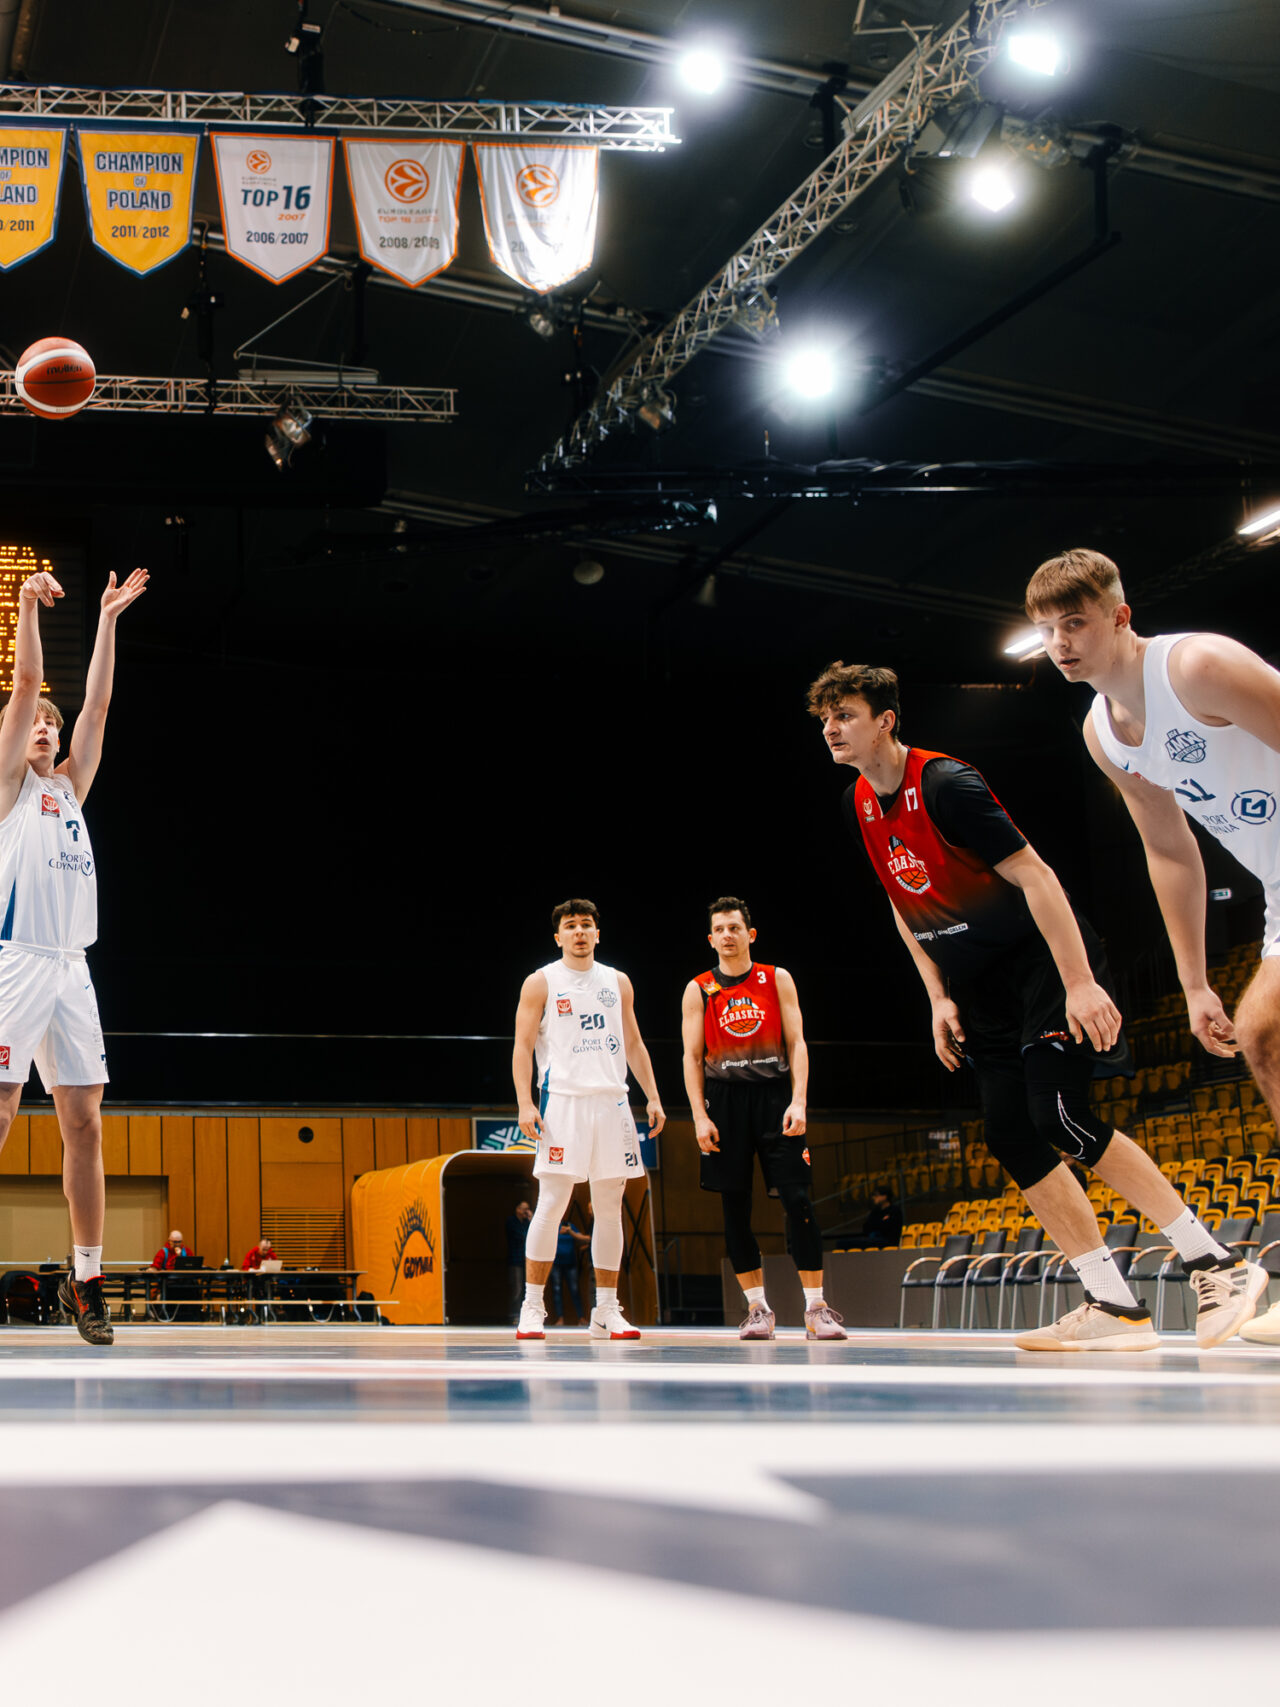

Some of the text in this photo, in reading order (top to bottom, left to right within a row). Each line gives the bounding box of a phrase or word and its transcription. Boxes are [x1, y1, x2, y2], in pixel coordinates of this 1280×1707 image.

[94, 152, 183, 174] CHAMPION
[0, 170, 11, 181] OF
[134, 176, 146, 187] OF
[106, 189, 173, 211] POLAND
[242, 185, 311, 210] TOP 16
[278, 213, 306, 221] 2007
[111, 225, 170, 238] 2011/2012
[246, 230, 308, 245] 2006/2007
[904, 787, 919, 812] 17
[66, 820, 80, 842] 7
[756, 971, 767, 984] 3
[579, 1013, 605, 1030] 20
[719, 1009, 766, 1027] ELBASKET
[573, 1045, 603, 1053] GDYNIA
